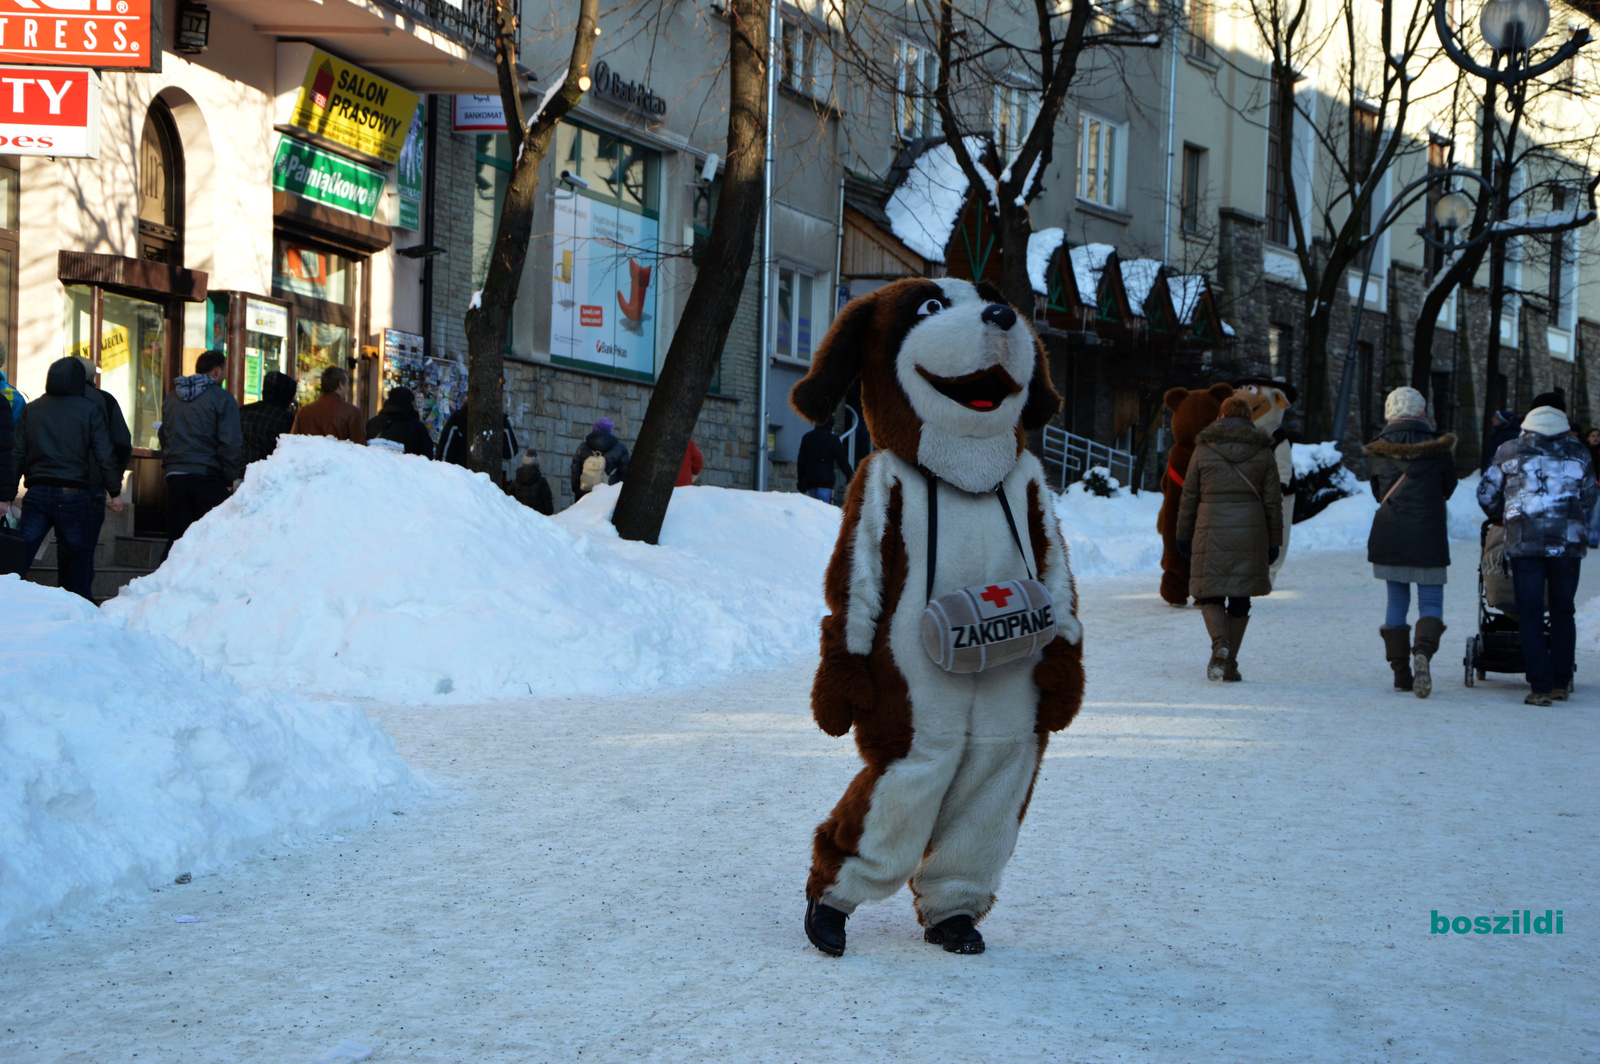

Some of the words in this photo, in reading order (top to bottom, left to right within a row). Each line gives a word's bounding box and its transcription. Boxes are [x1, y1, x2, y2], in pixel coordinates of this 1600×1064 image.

[2, 77, 73, 115] TY
[337, 69, 388, 107] SALON
[329, 93, 402, 138] PRASOWY
[463, 111, 503, 119] BANKOMAT
[285, 154, 369, 205] Pamiątkowo
[601, 341, 613, 355] Bank
[614, 344, 628, 358] Pekao
[951, 604, 1054, 648] ZAKOPANE
